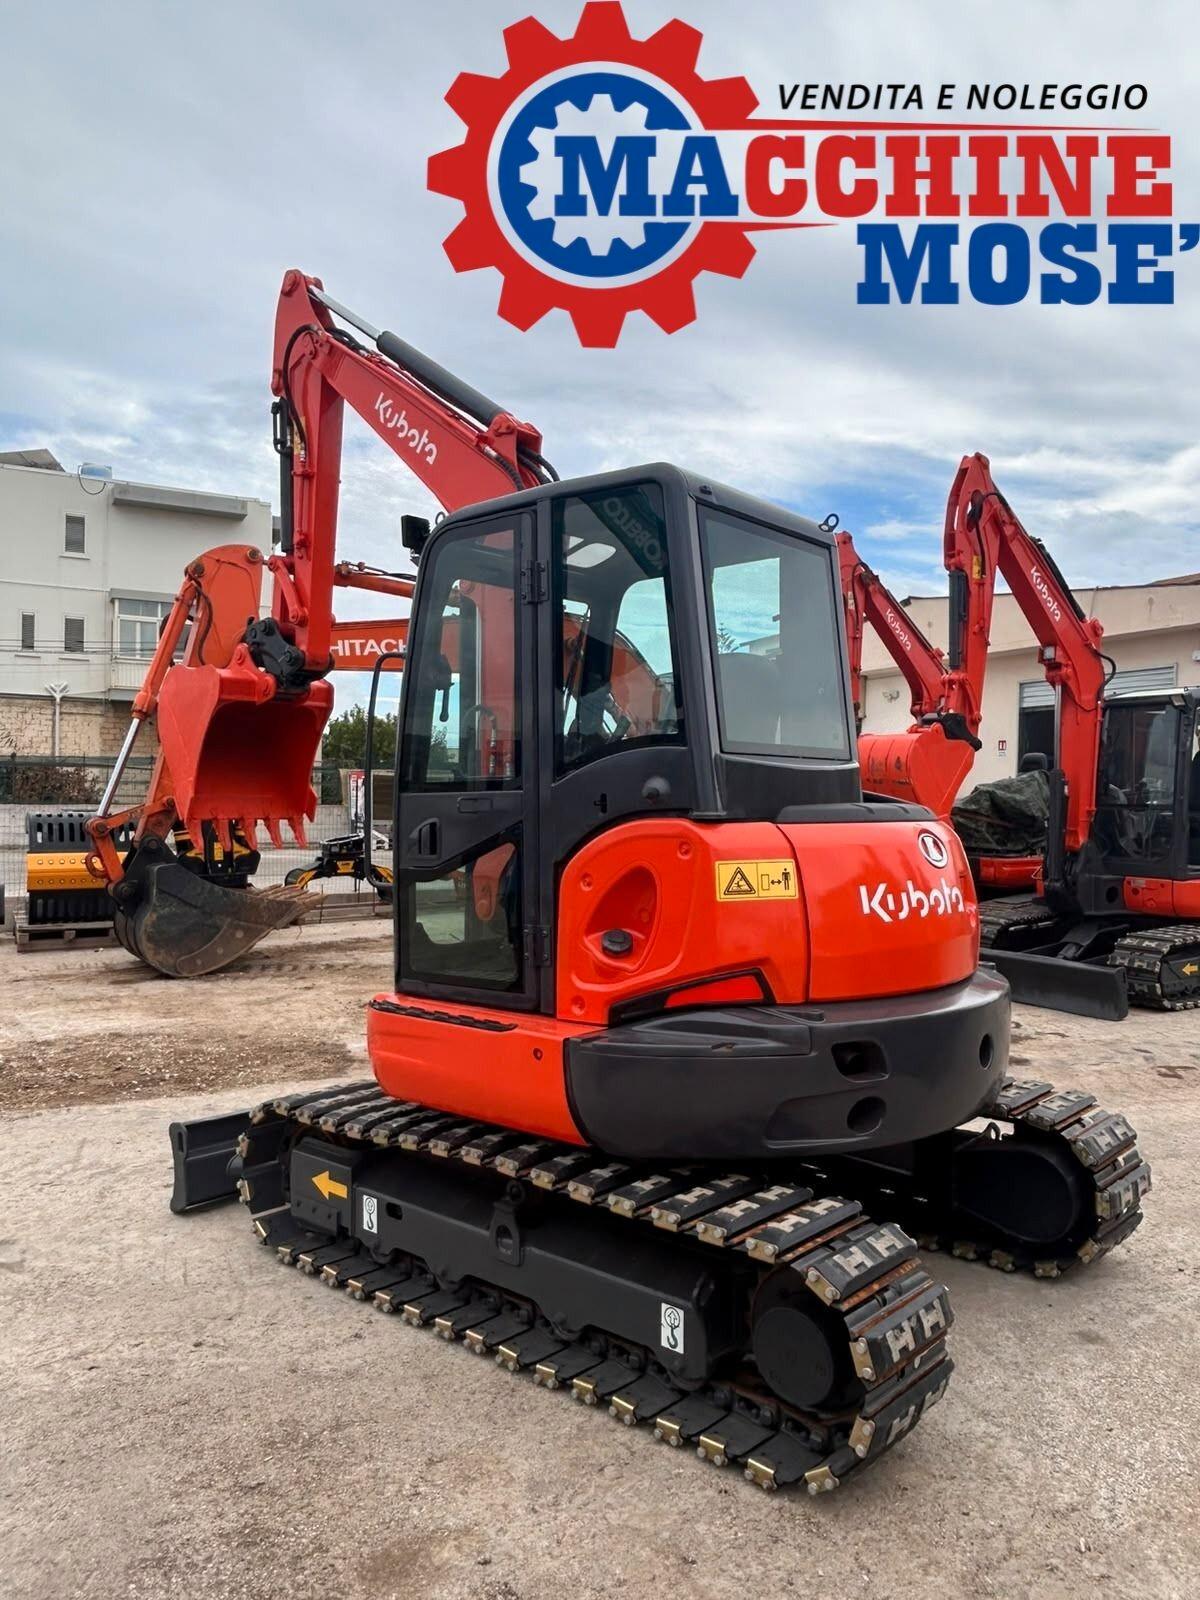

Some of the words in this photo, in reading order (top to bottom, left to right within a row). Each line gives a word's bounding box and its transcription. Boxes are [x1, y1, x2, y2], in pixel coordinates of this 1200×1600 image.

[375, 392, 437, 465] Kubota
[1031, 566, 1061, 622] Kubota
[886, 608, 912, 651] Kubota
[859, 877, 965, 923] Kubota
